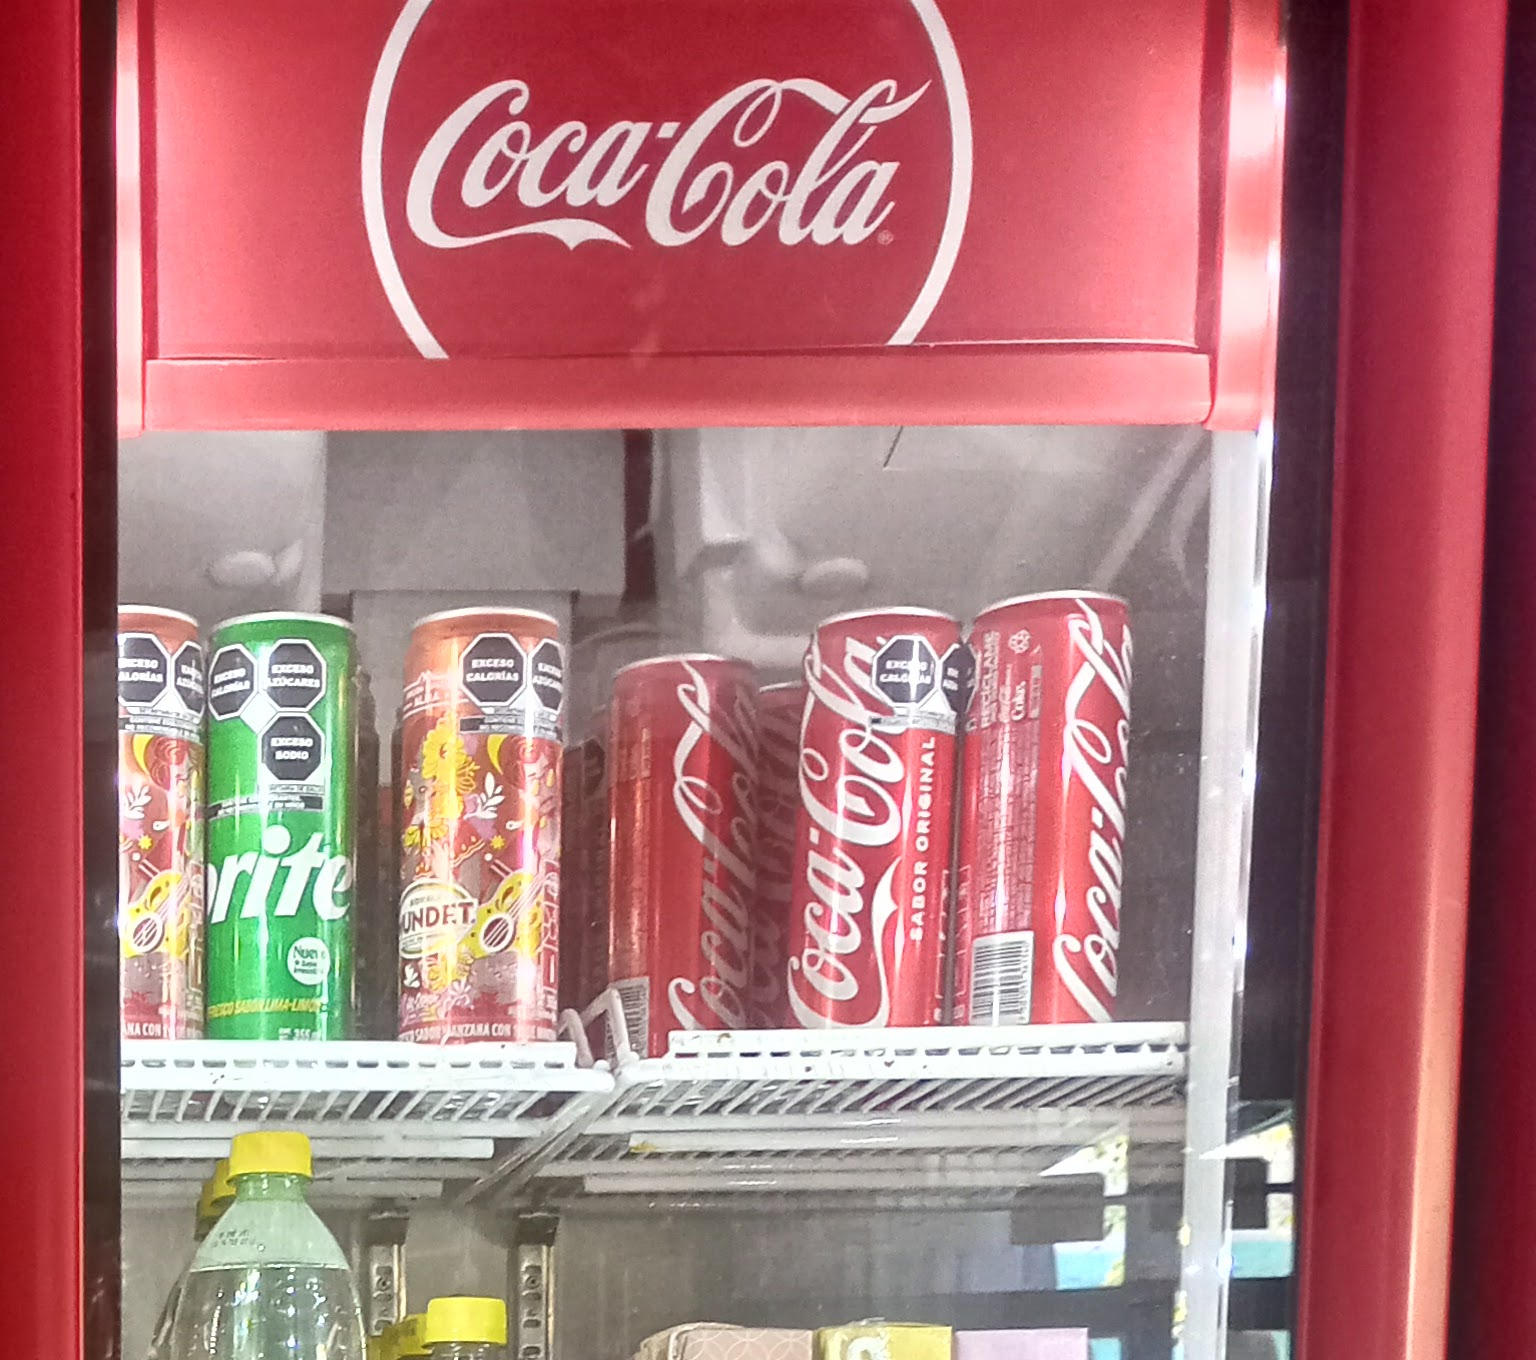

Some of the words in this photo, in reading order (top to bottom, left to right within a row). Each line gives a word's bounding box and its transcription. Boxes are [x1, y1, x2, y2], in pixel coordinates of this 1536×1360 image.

[406, 79, 932, 250] Coca-Cola
[271, 664, 314, 674] EXCESO
[471, 658, 515, 669] EXCESO
[118, 671, 163, 683] ALORÍAS
[465, 671, 520, 683] CALORÍAS
[271, 737, 313, 747] EXCESO
[275, 750, 309, 760] SODIO
[915, 735, 937, 850] ORIGINAL
[787, 633, 904, 1028] Coca-Cola
[910, 857, 930, 942] SABOR
